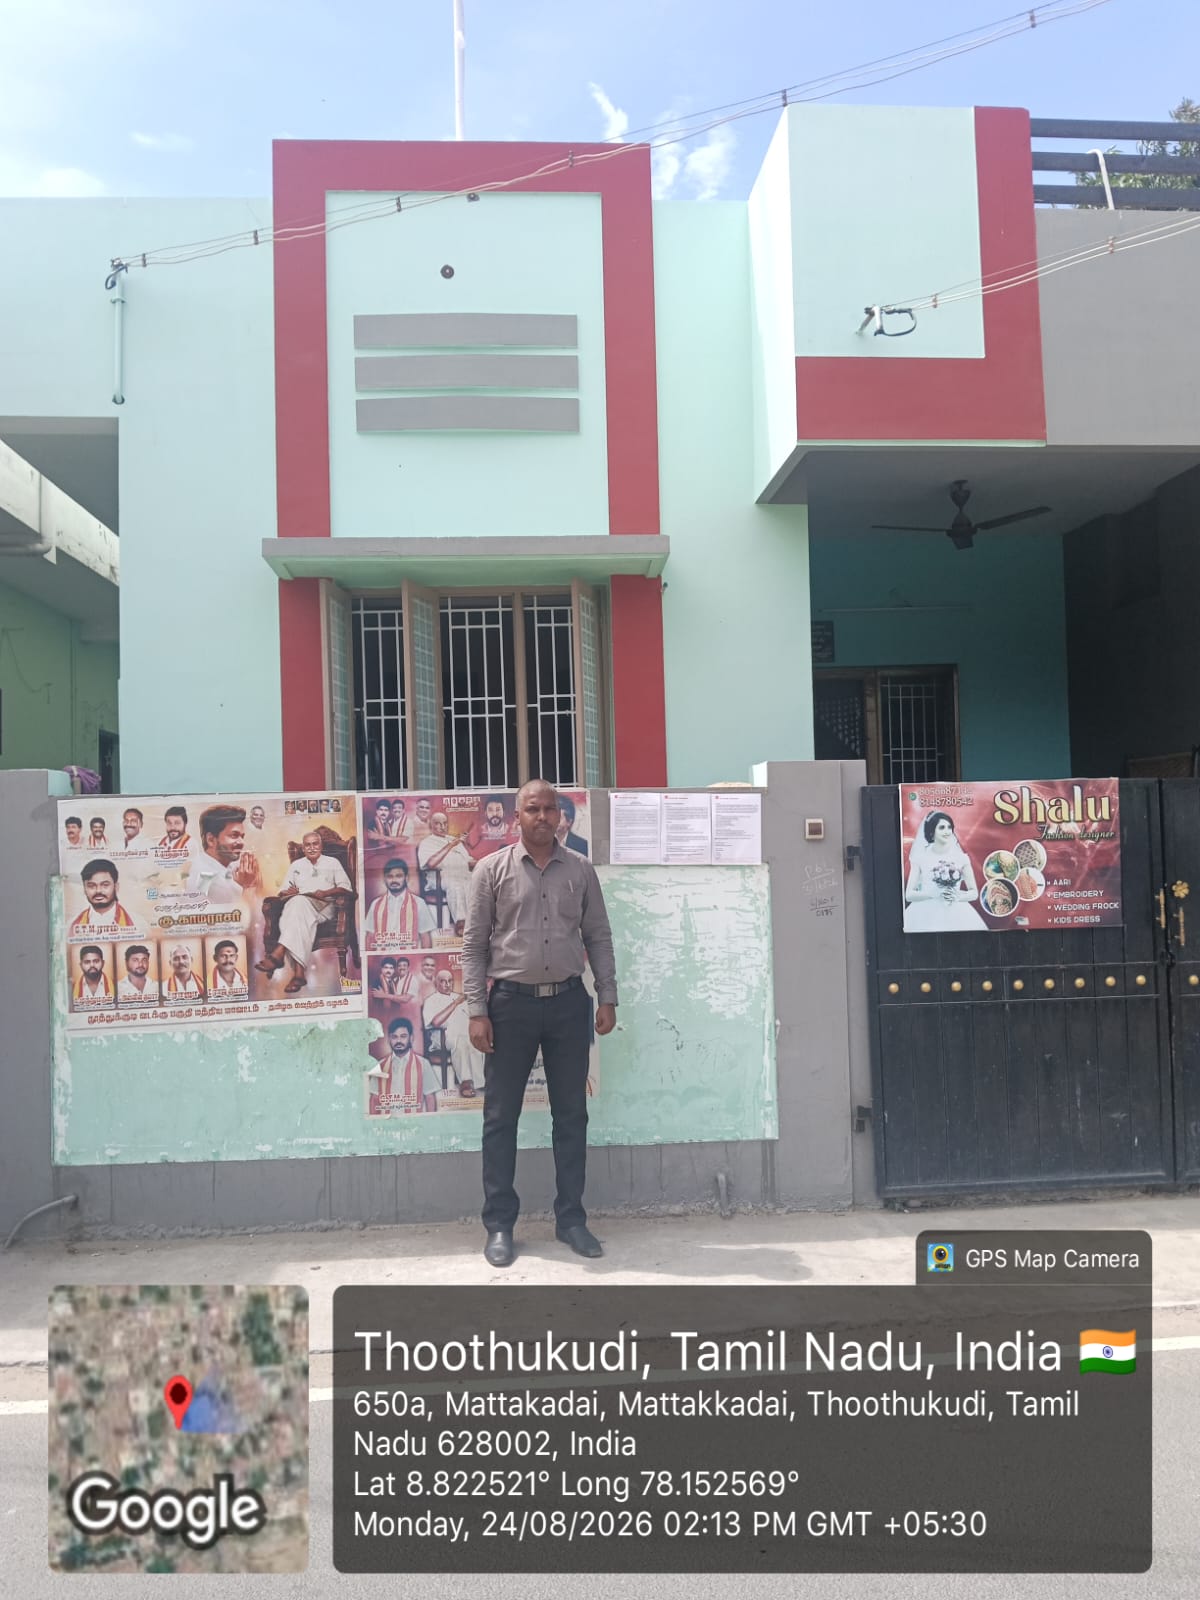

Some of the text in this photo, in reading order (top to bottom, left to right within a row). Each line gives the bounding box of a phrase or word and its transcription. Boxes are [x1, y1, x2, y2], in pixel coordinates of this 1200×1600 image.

[993, 784, 1111, 825] Shalu
[1036, 824, 1116, 842] Fashion designer
[1053, 890, 1105, 899] EMBROIDERY
[1053, 902, 1120, 911] WEDDING FROCK
[1053, 915, 1101, 924] KIDS DRESS
